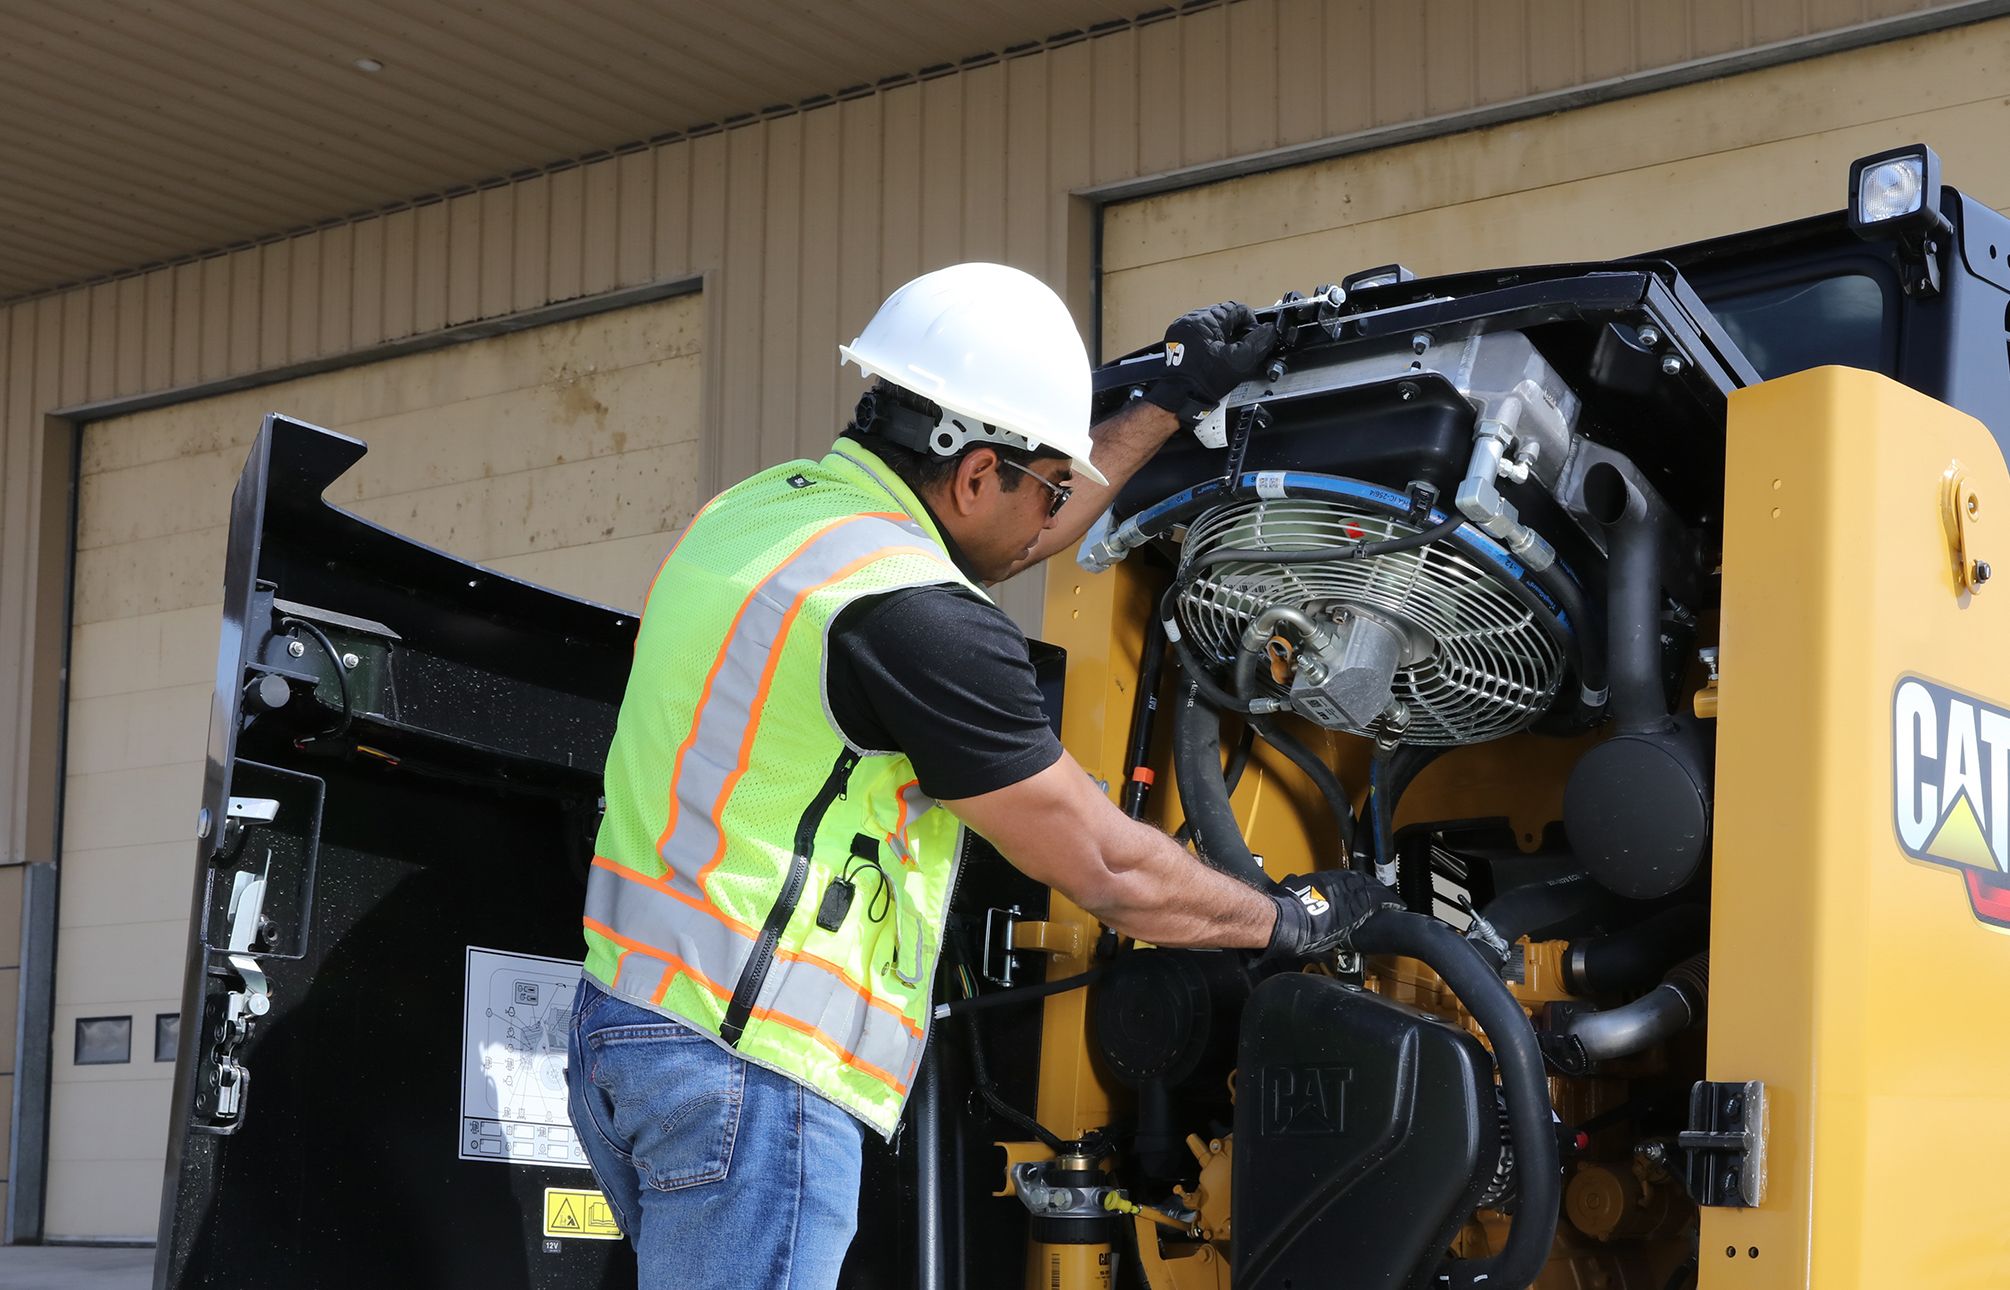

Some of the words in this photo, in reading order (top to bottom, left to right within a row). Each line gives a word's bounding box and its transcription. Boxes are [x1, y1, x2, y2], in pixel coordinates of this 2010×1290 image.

[1165, 342, 1185, 367] CA
[1148, 696, 1158, 711] CAT
[1896, 681, 2010, 873] CAT
[1285, 885, 1330, 916] CAT
[1261, 1067, 1354, 1136] CAT
